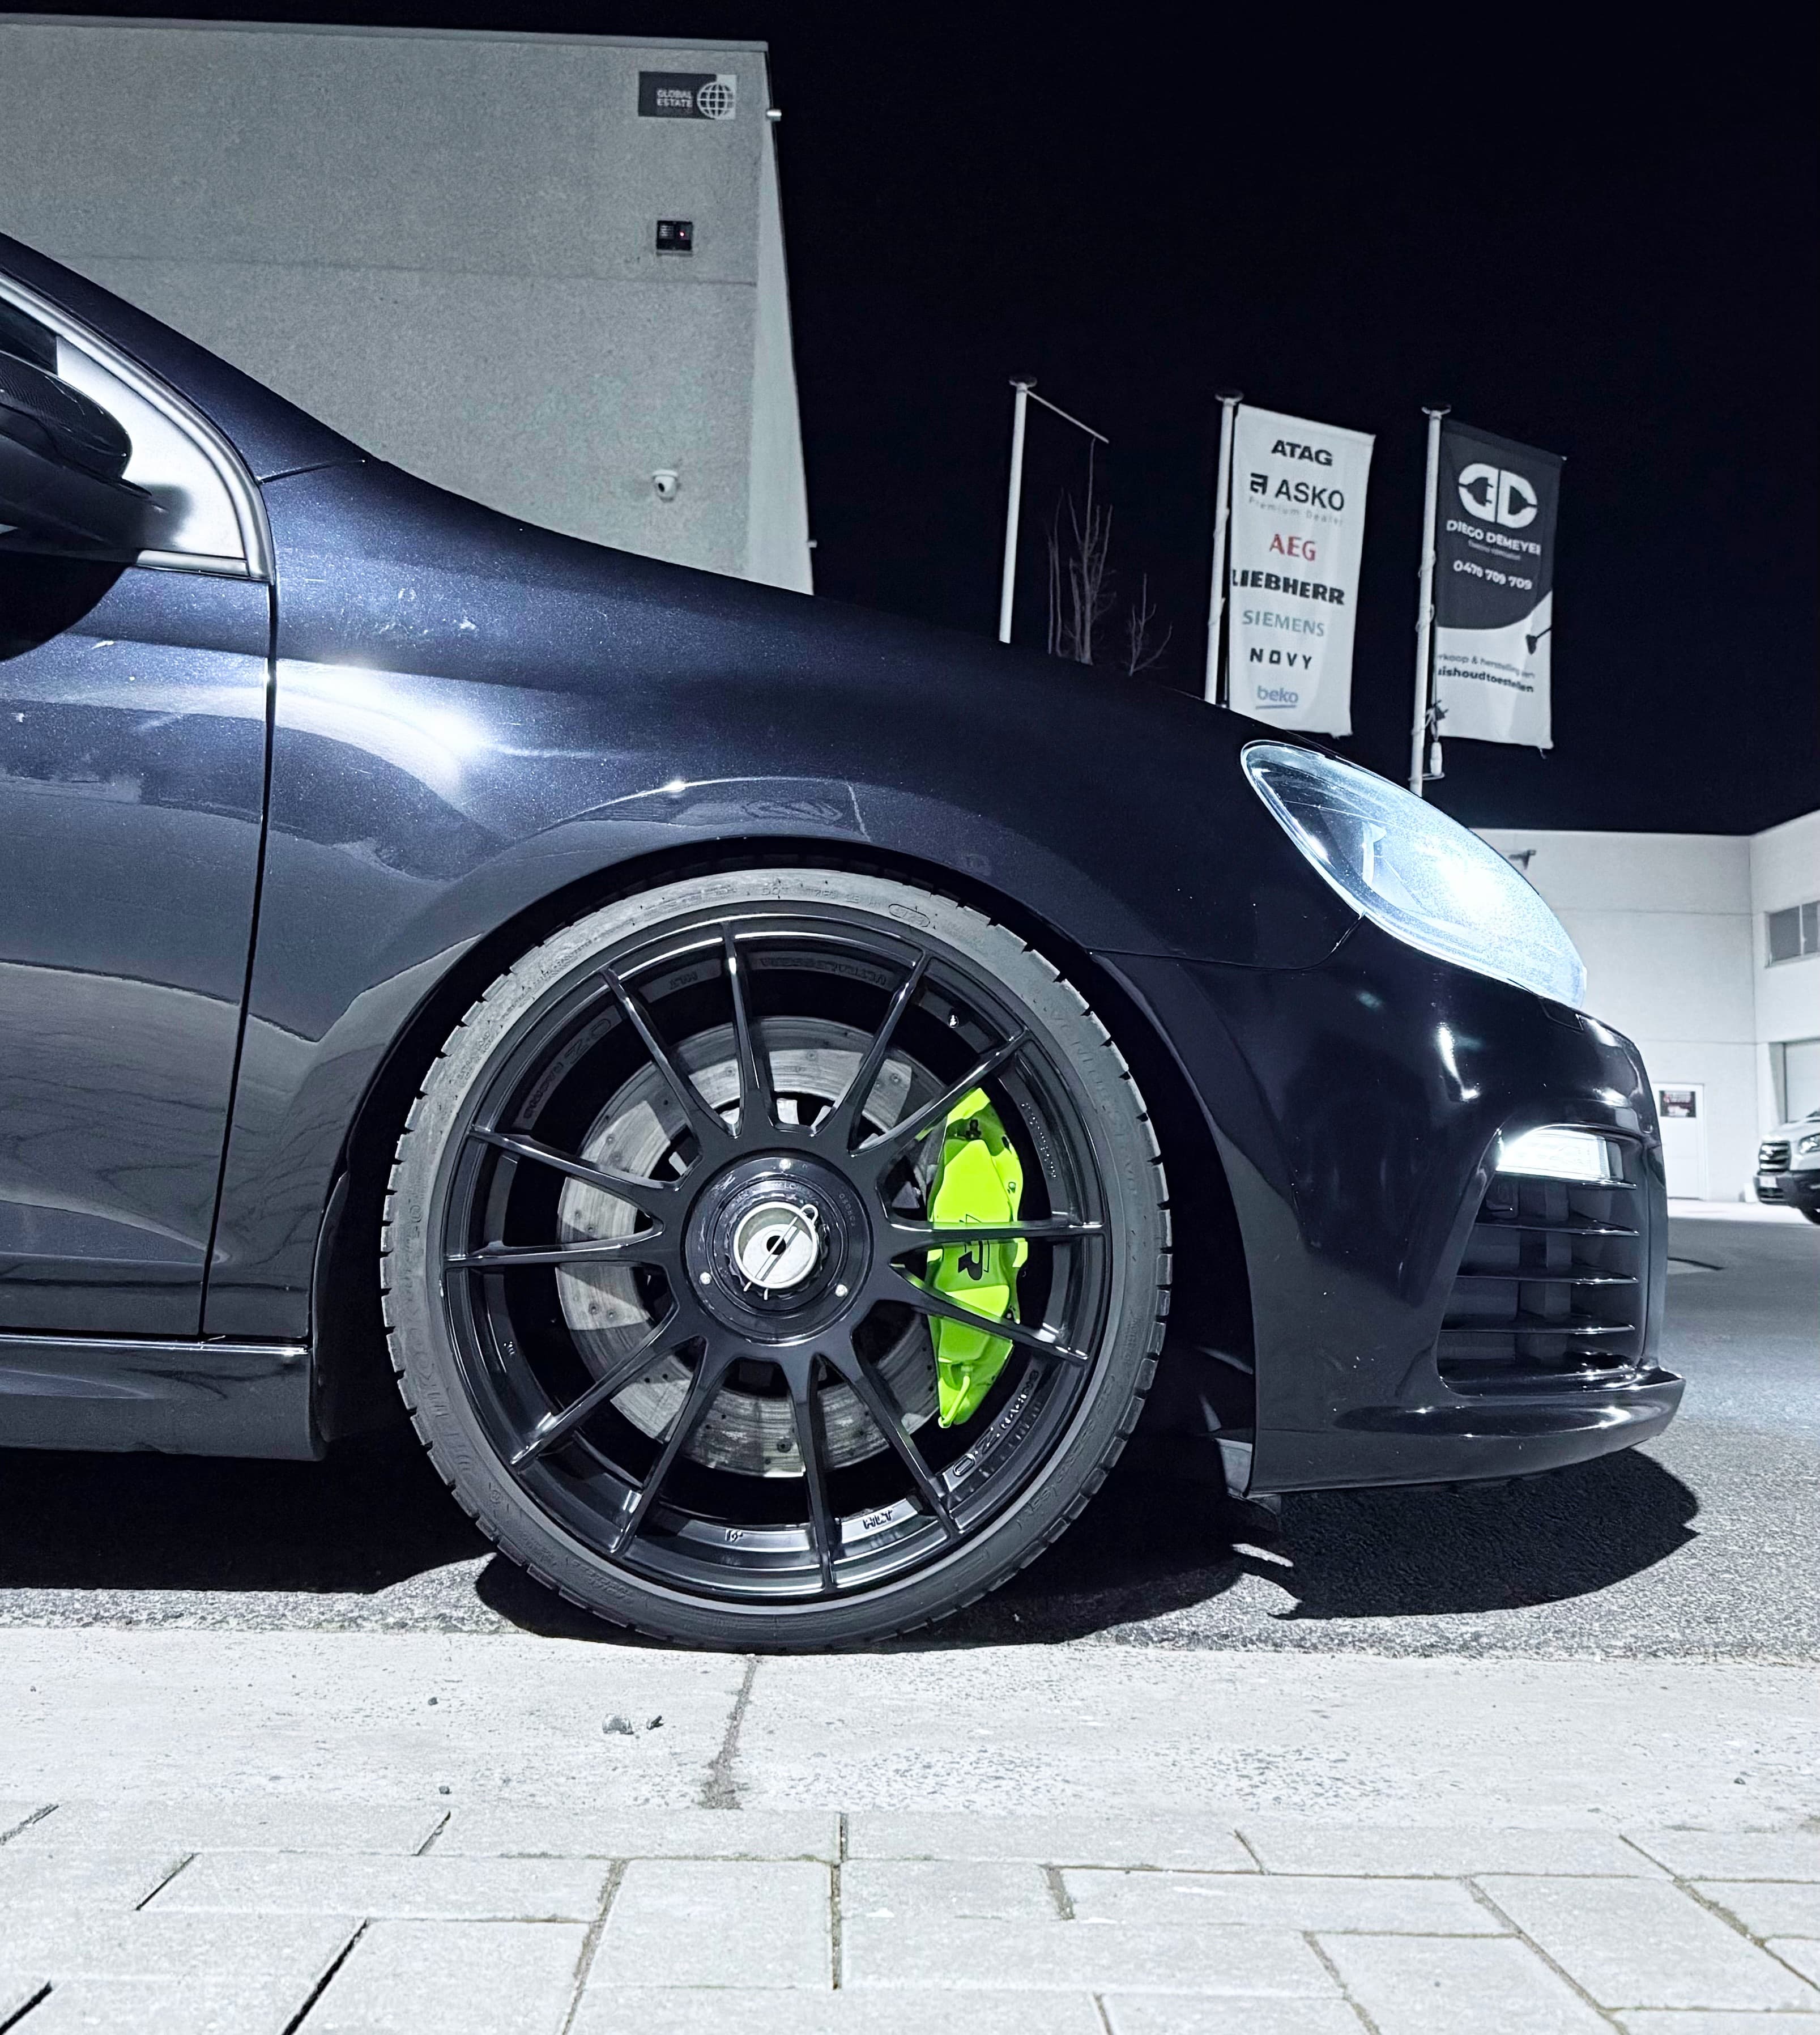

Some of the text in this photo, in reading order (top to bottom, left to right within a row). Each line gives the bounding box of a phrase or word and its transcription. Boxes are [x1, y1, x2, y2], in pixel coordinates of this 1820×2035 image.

[657, 89, 692, 99] GLOBAL
[657, 99, 693, 108] ESTATE
[1271, 440, 1333, 466] ATAG
[1275, 479, 1344, 511] ASKO
[1446, 519, 1484, 540] DIEGO
[1269, 534, 1316, 562] AEG
[1232, 569, 1345, 606] LIEBHERR
[1242, 609, 1324, 637] SIEMENS
[1250, 648, 1312, 670] NOVY
[1256, 685, 1299, 704] beko
